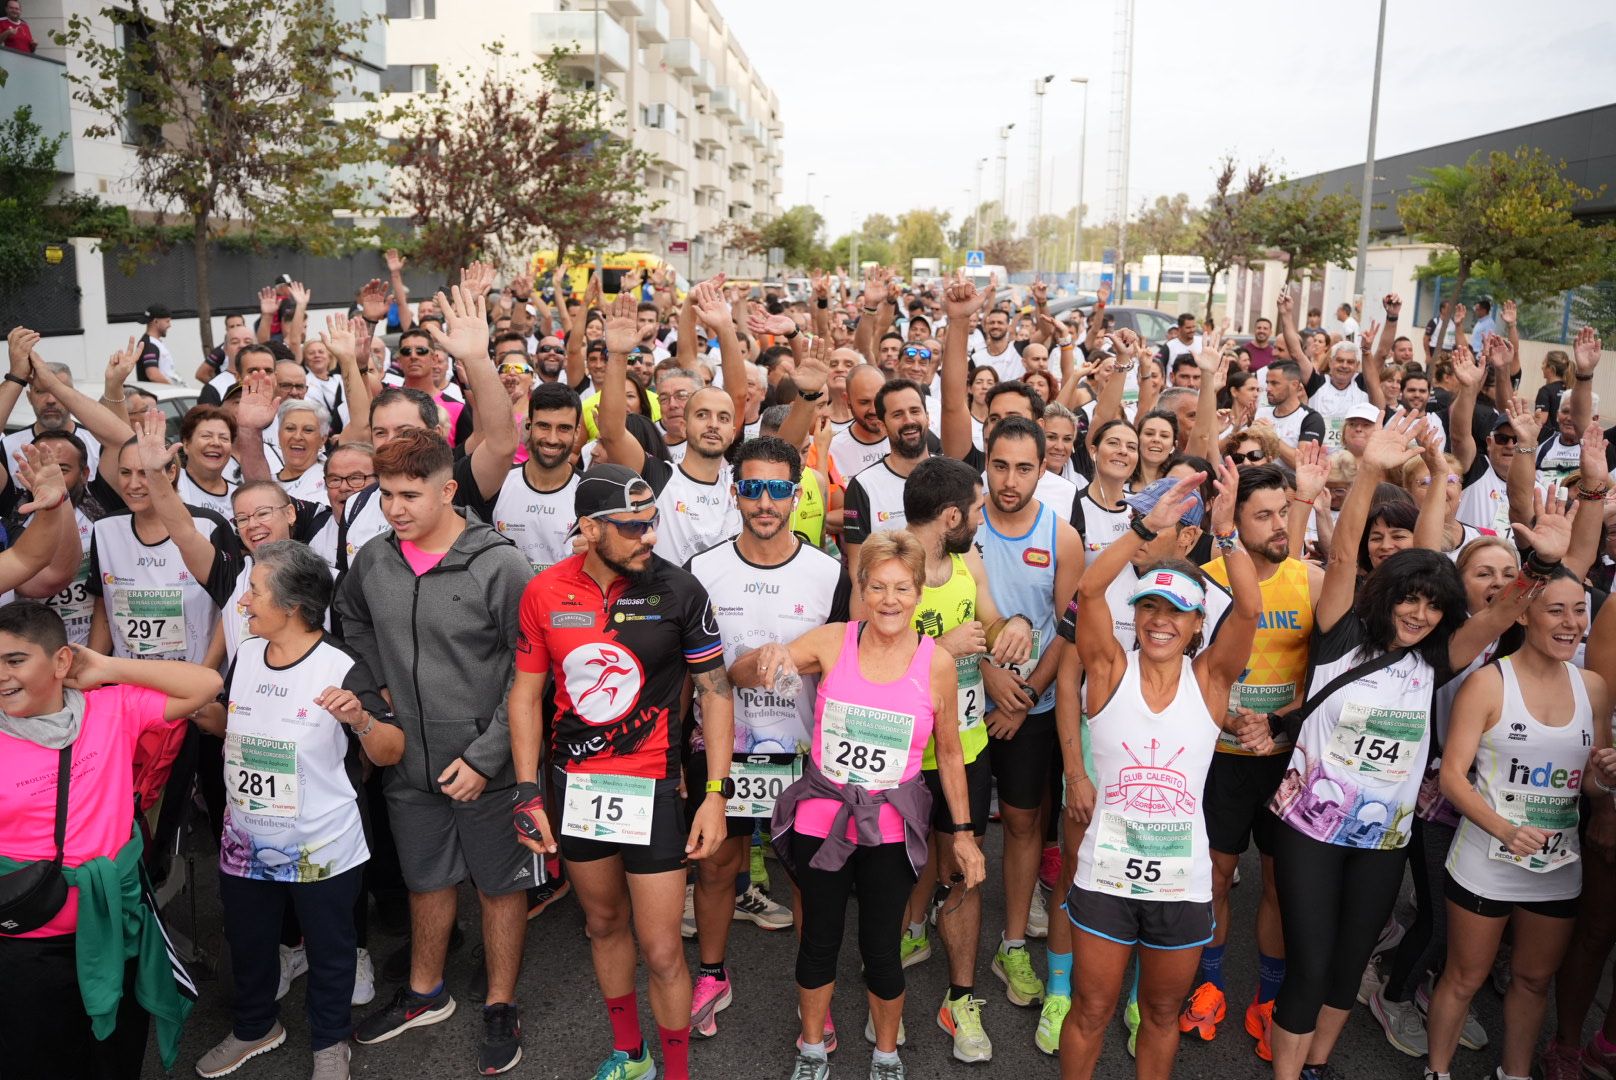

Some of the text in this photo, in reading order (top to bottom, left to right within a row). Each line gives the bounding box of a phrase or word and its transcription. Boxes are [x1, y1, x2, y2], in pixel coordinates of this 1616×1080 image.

[526, 503, 555, 515] JOYLU
[136, 556, 167, 567] JOYLU
[144, 590, 181, 598] POPULAR
[743, 581, 780, 595] JOYLU
[127, 619, 166, 639] 297
[256, 683, 288, 698] JOYLU
[1260, 684, 1294, 695] POPULAR
[743, 690, 796, 709] Peñas
[868, 710, 912, 727] POPULAR
[1389, 710, 1426, 720] POPULAR
[257, 739, 295, 751] POPULAR
[1354, 736, 1401, 764] 154
[835, 741, 887, 773] 285
[1124, 772, 1183, 789] CLUB CALERITO
[1508, 757, 1583, 789] indea
[237, 770, 276, 798] 281
[591, 795, 624, 822] 15
[1147, 823, 1192, 832] POPULAR
[1124, 857, 1162, 883] 55
[1096, 878, 1115, 887] PIEDRA
